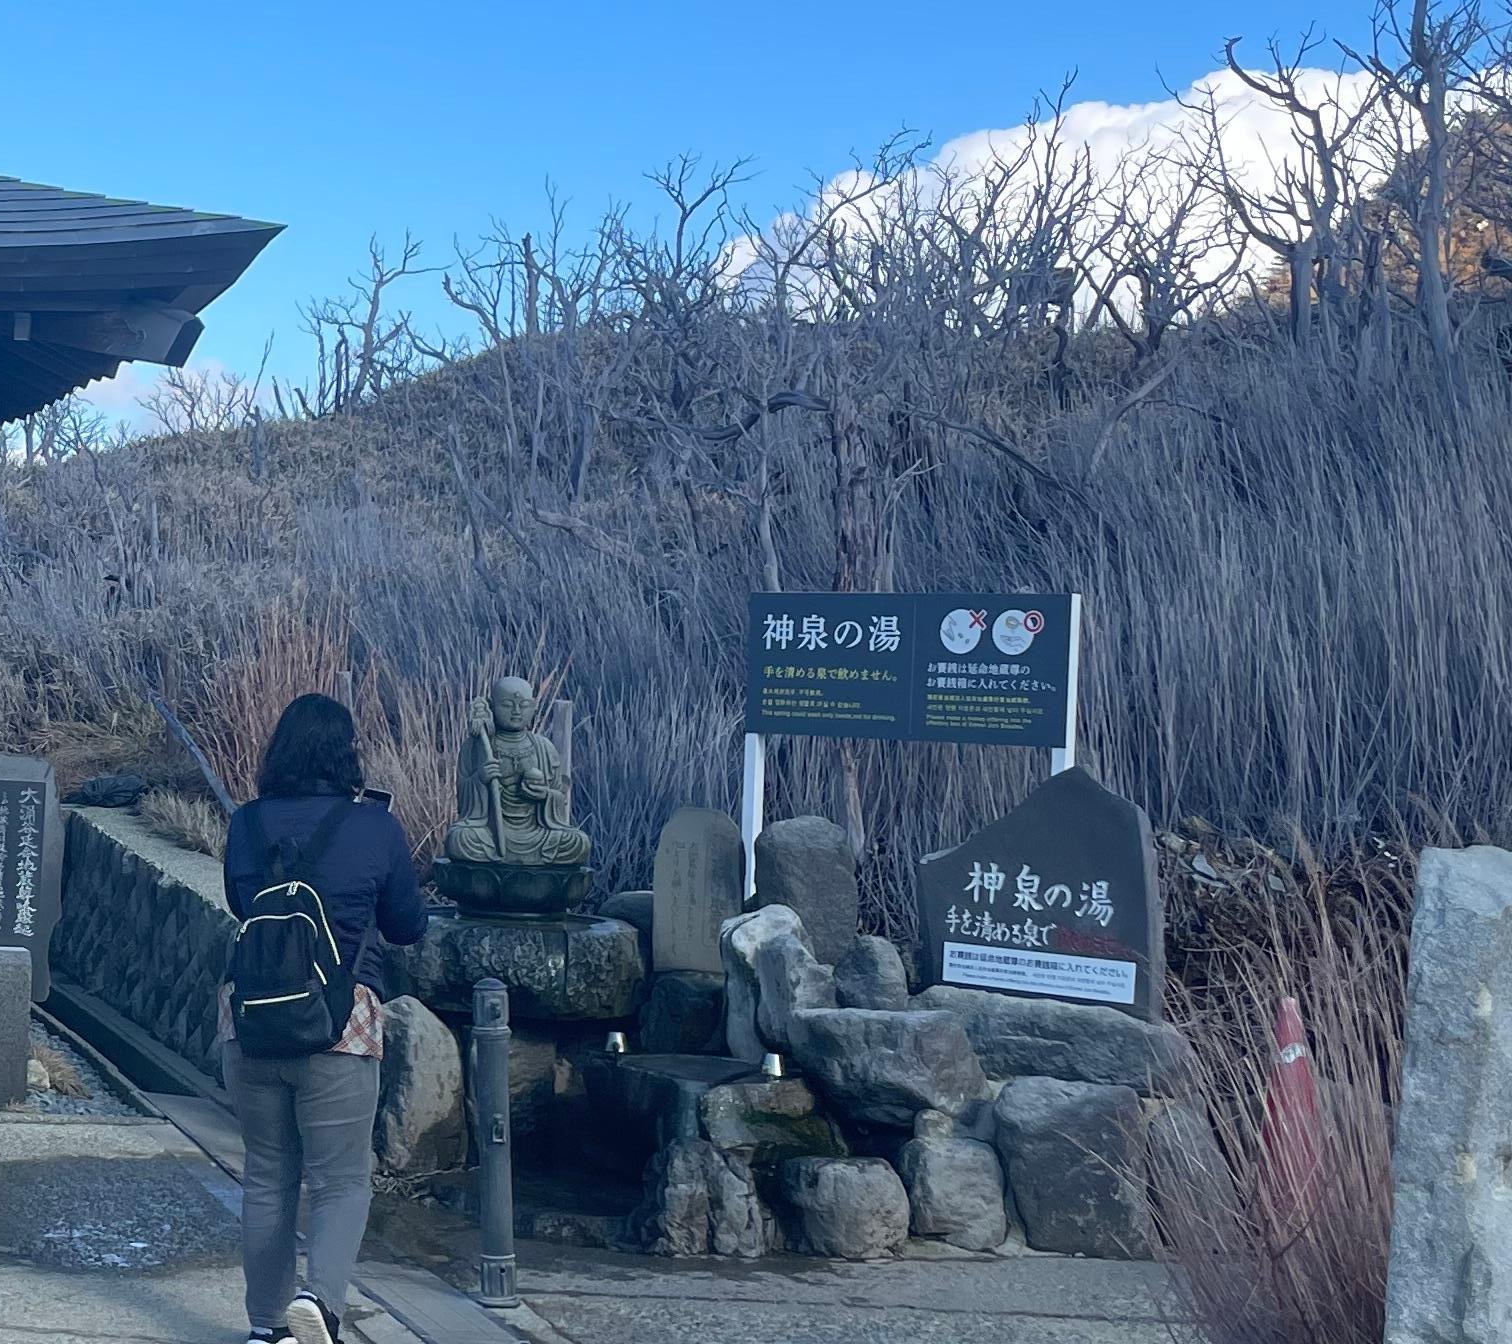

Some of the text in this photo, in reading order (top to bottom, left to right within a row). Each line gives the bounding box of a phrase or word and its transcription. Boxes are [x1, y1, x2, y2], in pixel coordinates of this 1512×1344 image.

[761, 613, 901, 653] 神泉の湯
[964, 861, 1114, 927] 神泉の湯
[945, 904, 1057, 947] 手を清める泉で
